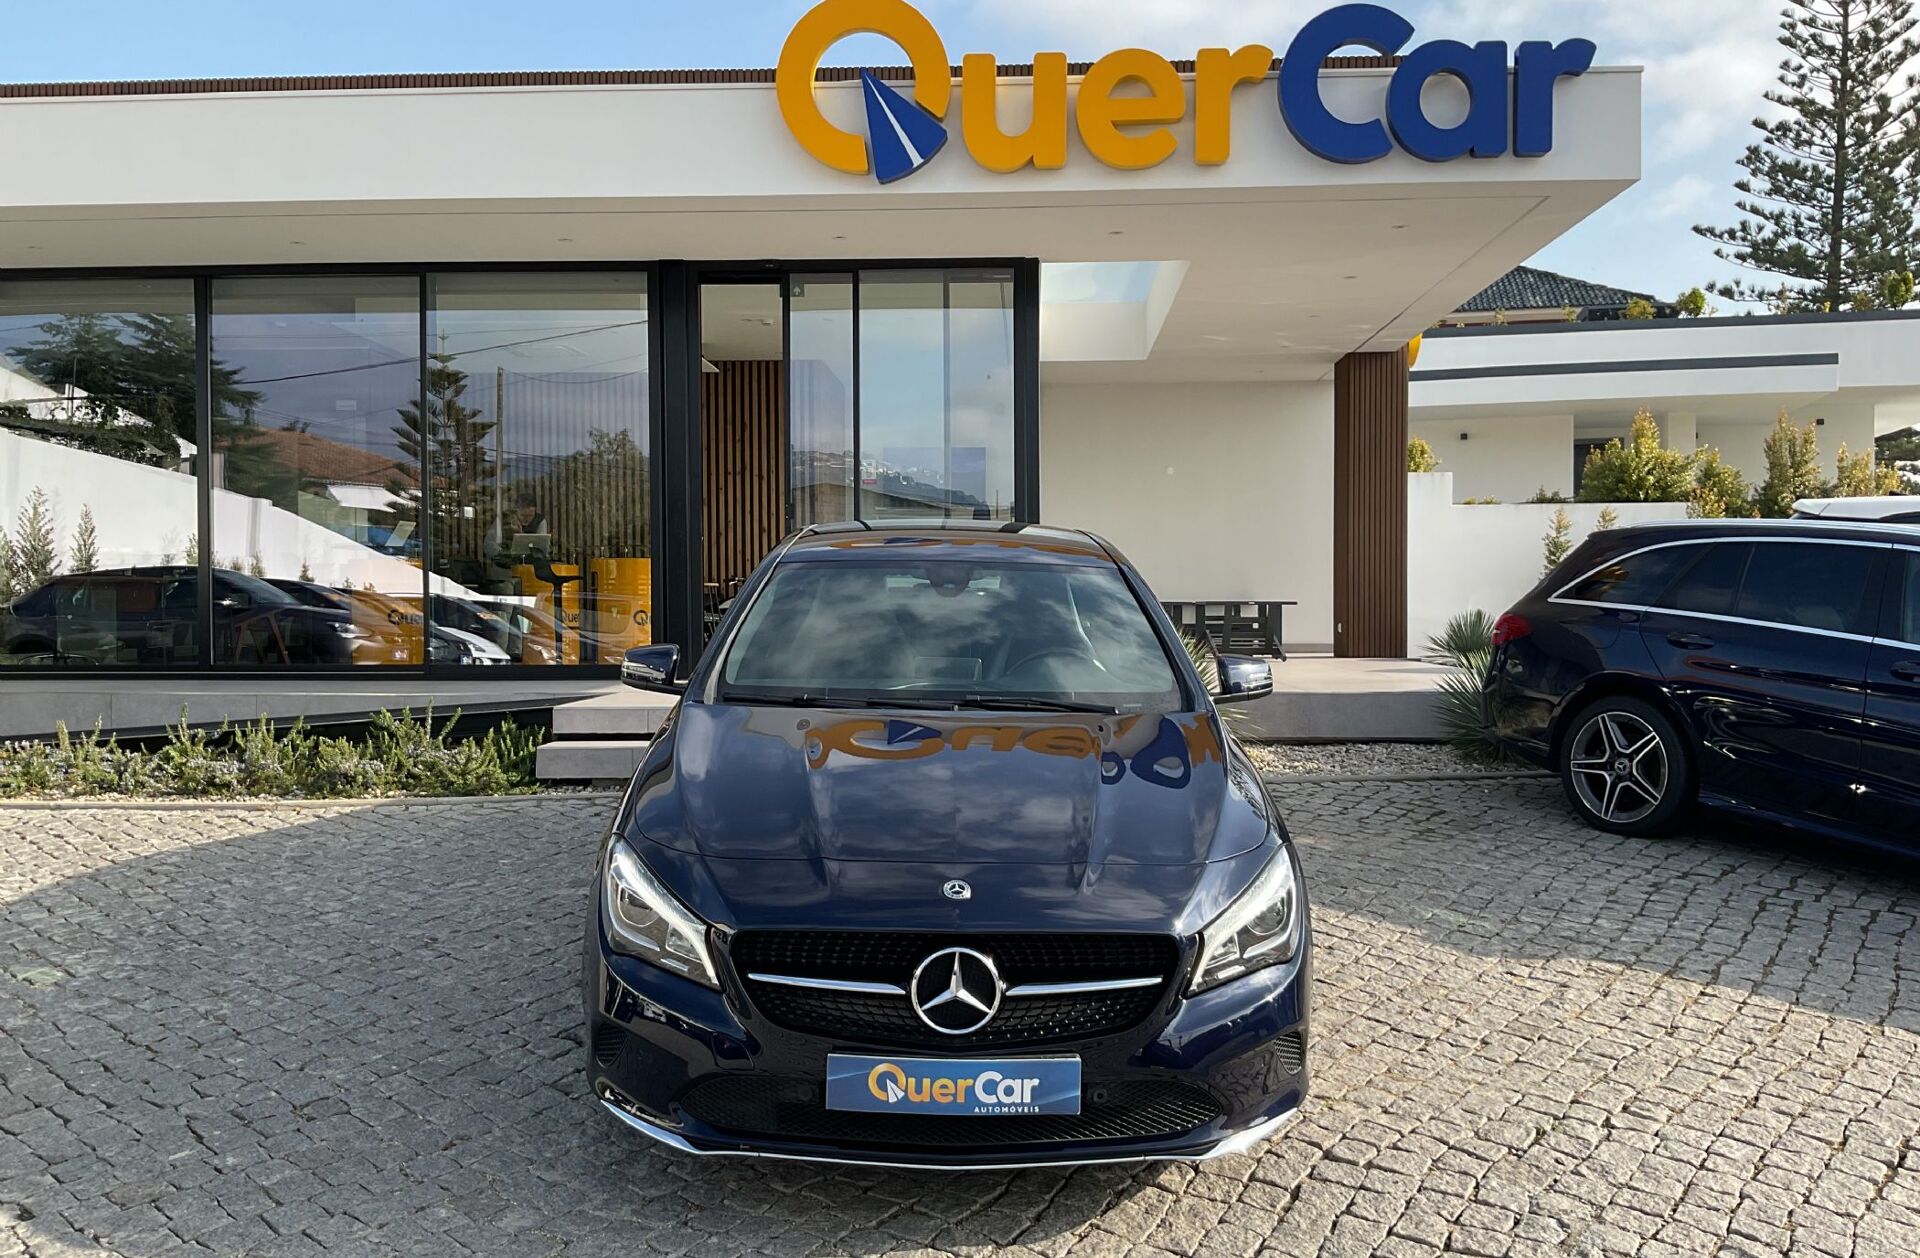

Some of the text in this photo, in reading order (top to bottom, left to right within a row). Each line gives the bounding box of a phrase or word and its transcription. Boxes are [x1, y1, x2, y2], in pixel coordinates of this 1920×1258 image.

[776, 0, 1596, 184] QuerCar
[868, 1063, 1040, 1103] QuerCar
[974, 1105, 1040, 1113] AUTOMÓVEIS
